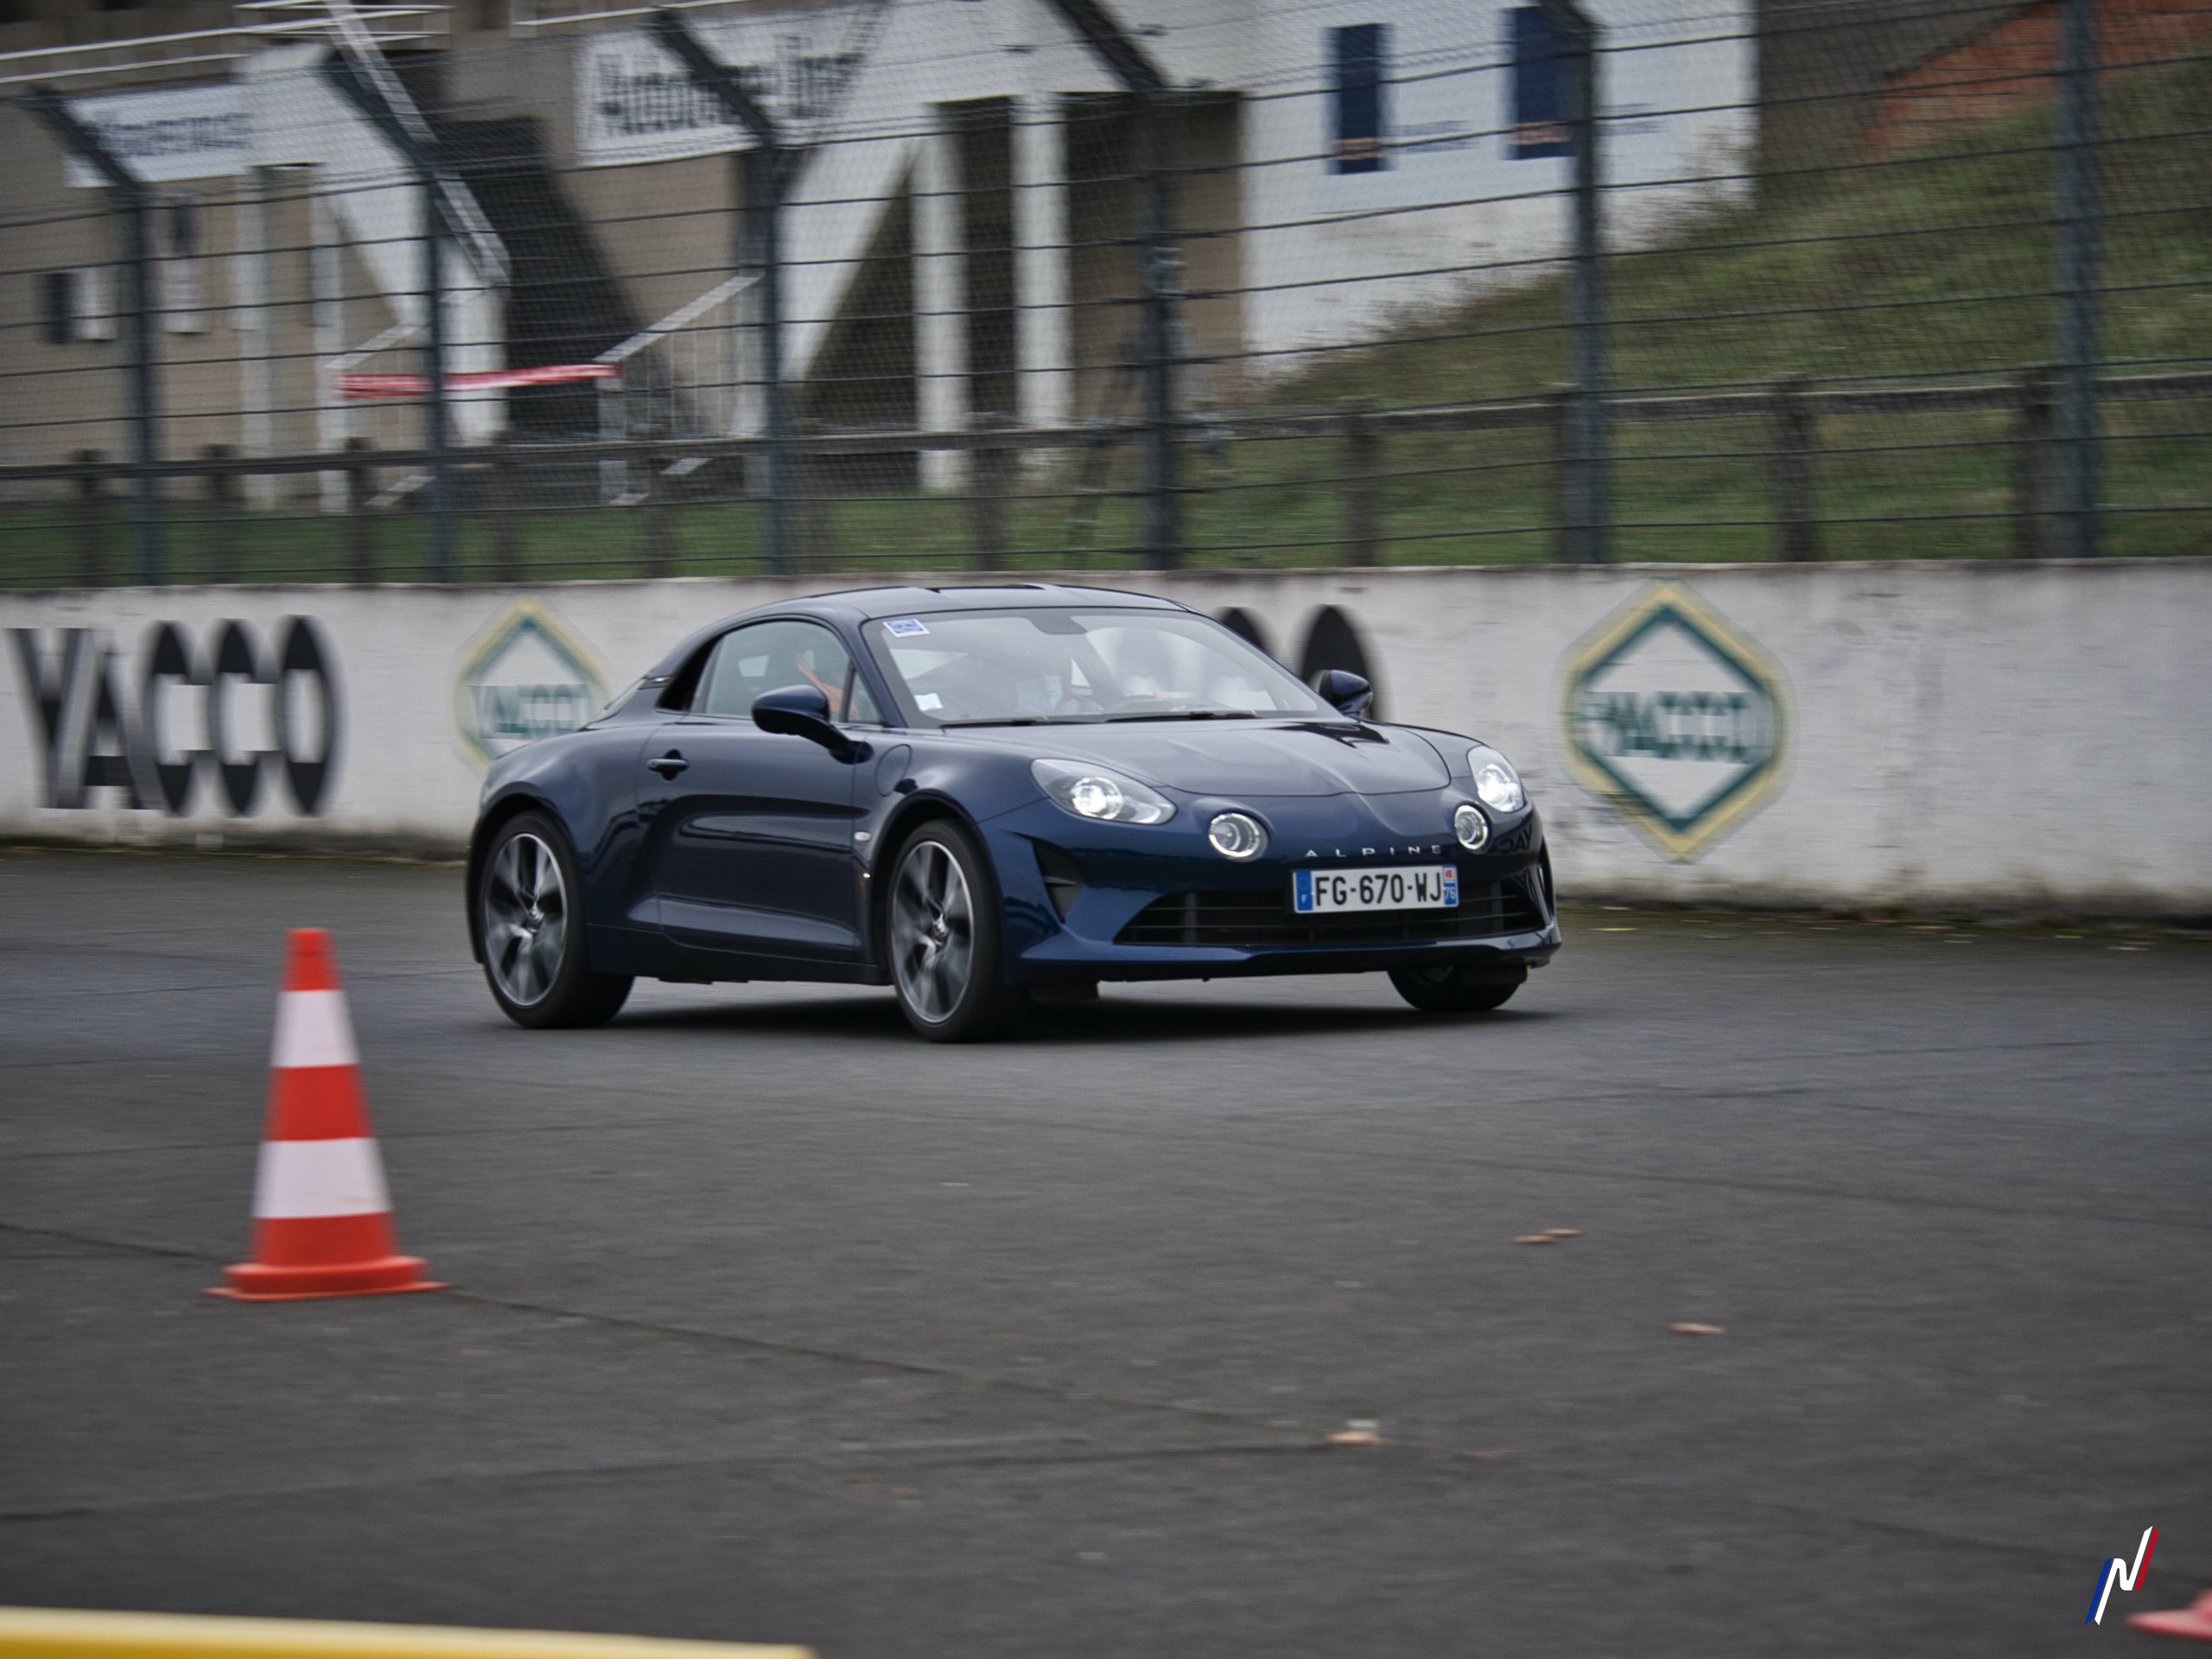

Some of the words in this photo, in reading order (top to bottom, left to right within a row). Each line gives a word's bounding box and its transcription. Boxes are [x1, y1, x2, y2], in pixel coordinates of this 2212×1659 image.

[4, 614, 348, 818] YACCO
[1305, 844, 1442, 858] ALPINE
[1314, 871, 1442, 906] FG-670-WJ
